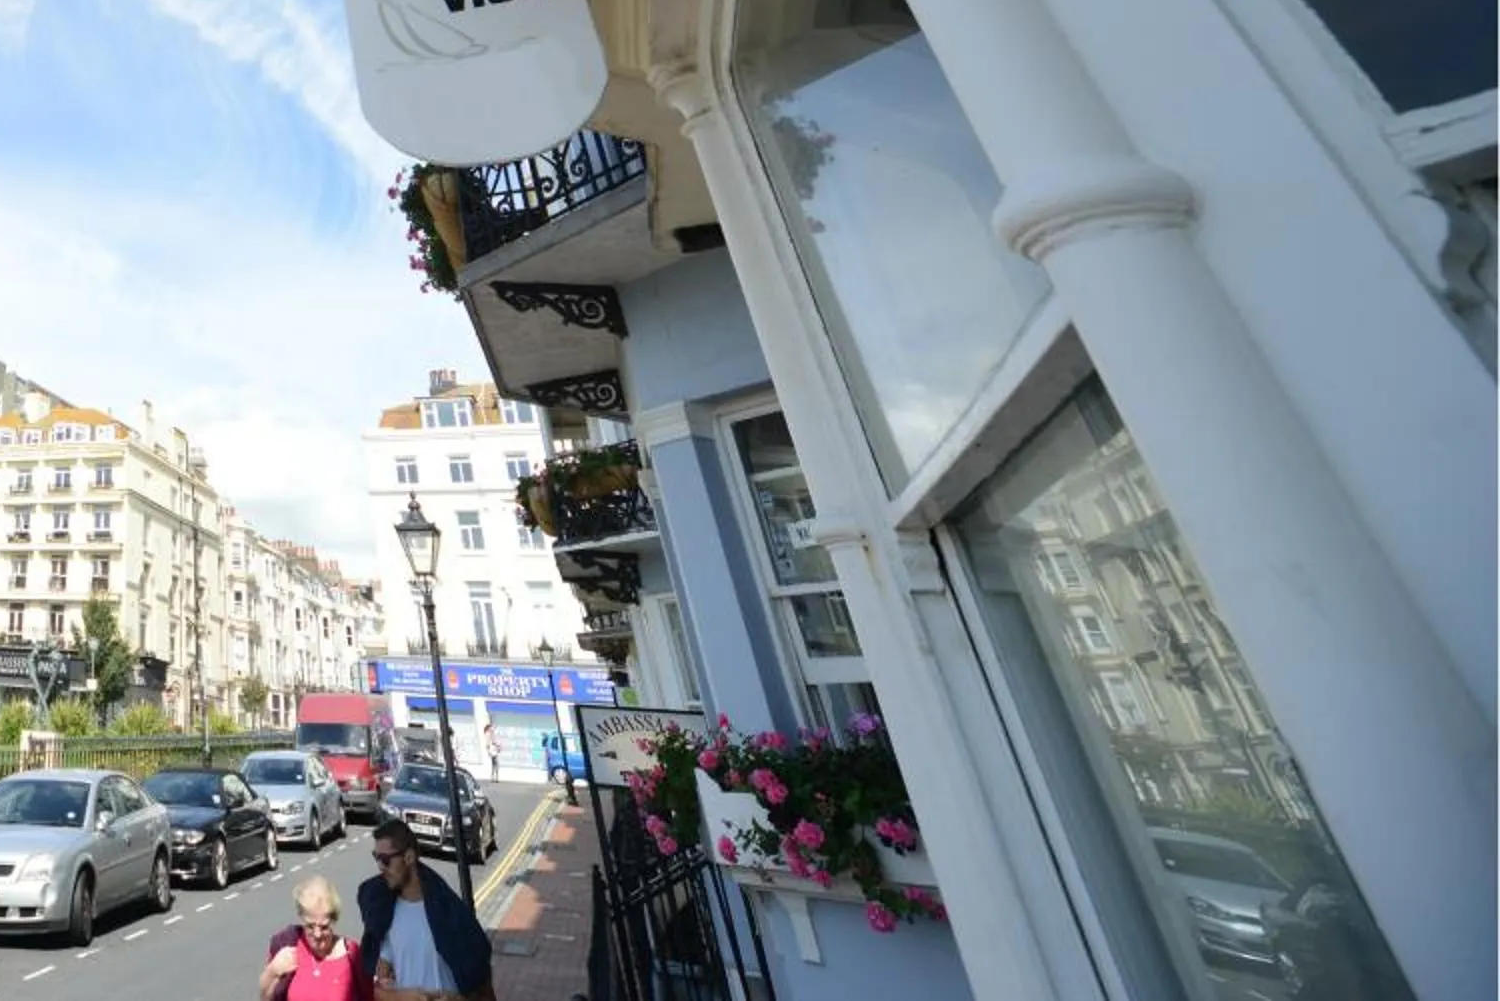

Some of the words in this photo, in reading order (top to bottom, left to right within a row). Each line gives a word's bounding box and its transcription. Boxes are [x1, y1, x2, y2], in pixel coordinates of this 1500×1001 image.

[467, 673, 549, 689] PROPERTY
[488, 684, 531, 697] SHOP
[587, 712, 680, 747] AMBASSA
